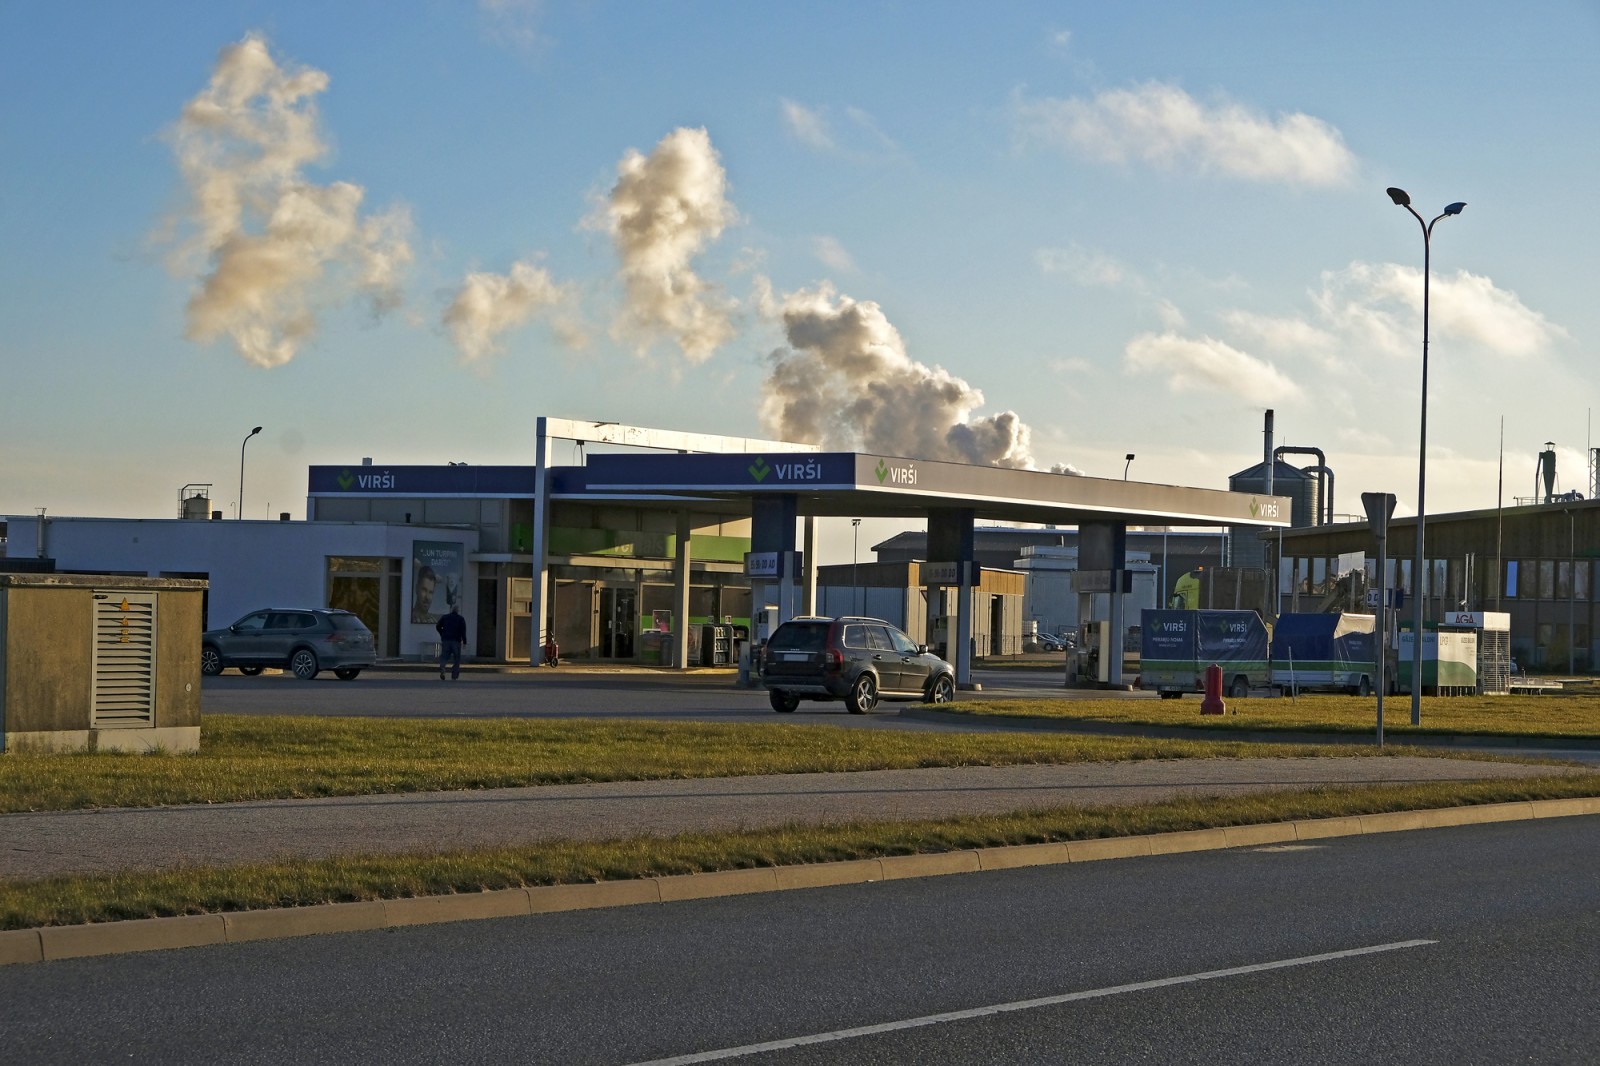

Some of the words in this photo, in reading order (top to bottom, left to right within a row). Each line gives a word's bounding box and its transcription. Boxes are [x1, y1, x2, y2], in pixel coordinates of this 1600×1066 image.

[774, 458, 822, 480] VIRŠI
[890, 463, 918, 485] VIRŠI
[357, 470, 395, 489] VIRŠI
[1260, 500, 1280, 518] VIRŠI
[1163, 620, 1187, 632] VIRŠI
[1229, 621, 1247, 633] VIRŠI
[1455, 612, 1474, 624] AGA
